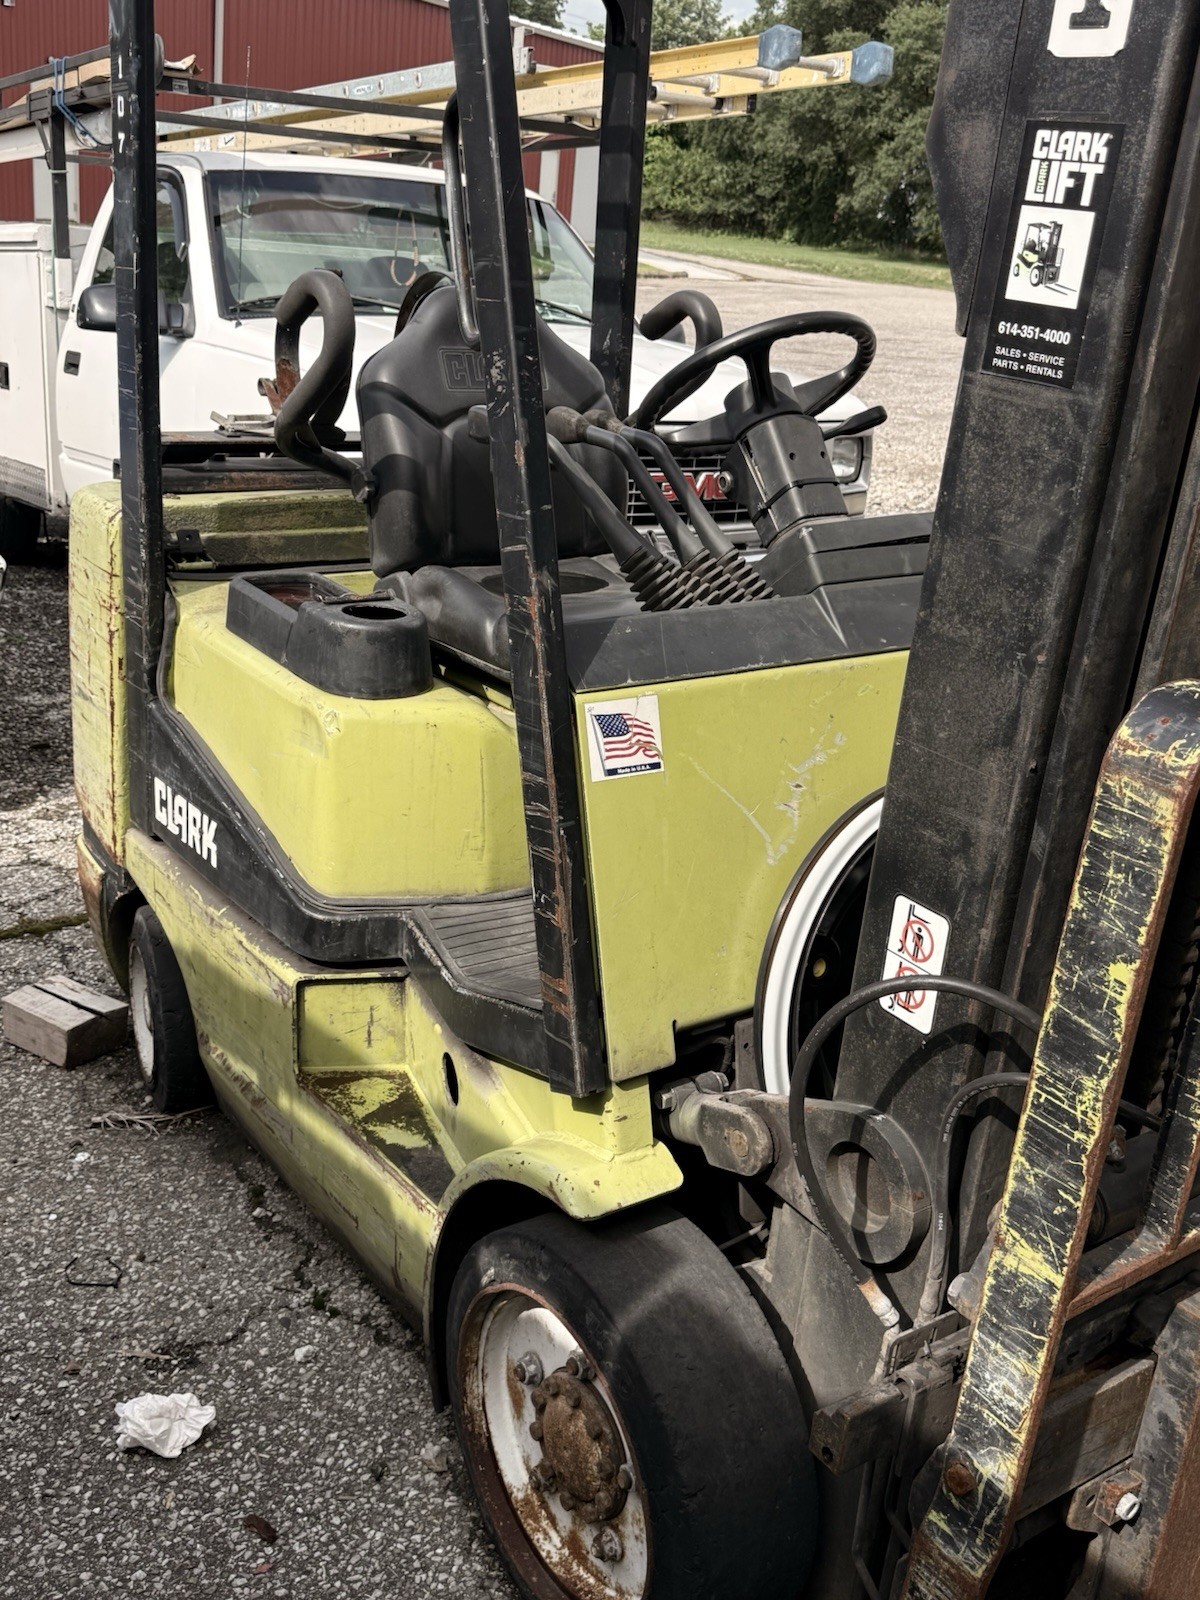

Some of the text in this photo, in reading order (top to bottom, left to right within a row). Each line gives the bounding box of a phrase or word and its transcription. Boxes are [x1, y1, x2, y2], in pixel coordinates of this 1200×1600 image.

[1033, 129, 1109, 163] CLARK
[1024, 159, 1105, 207] LIFT
[1035, 160, 1049, 193] CLARK
[998, 321, 1071, 345] 614-351-4000
[992, 358, 1063, 379] PARTS RENTALS
[995, 346, 1065, 366] SALES SERVICE
[154, 776, 218, 869] CLARK
